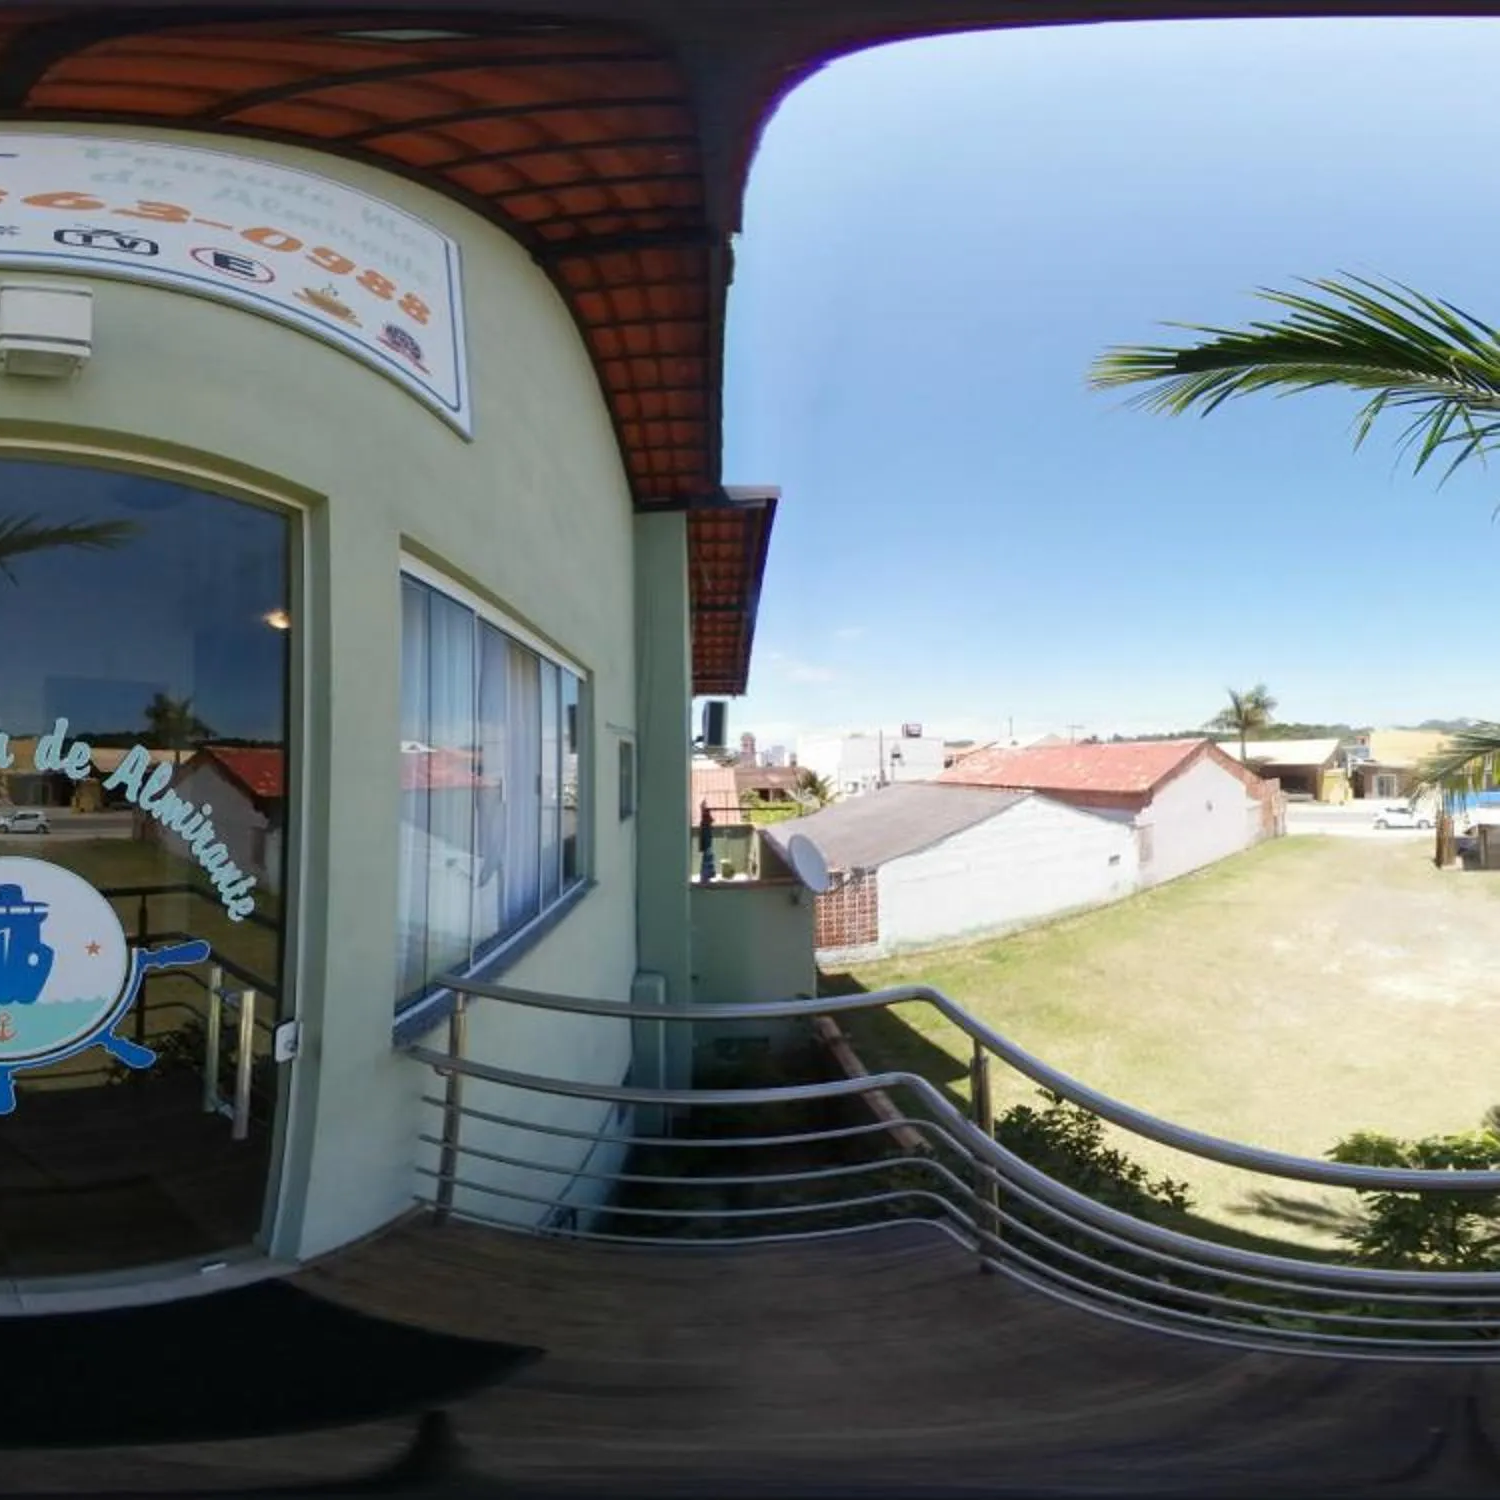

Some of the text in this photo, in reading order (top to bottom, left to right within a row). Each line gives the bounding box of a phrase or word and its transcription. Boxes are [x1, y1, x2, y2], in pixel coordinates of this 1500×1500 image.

[212, 250, 257, 278] E
[34, 716, 92, 782] de
[103, 744, 257, 922] Almirante
